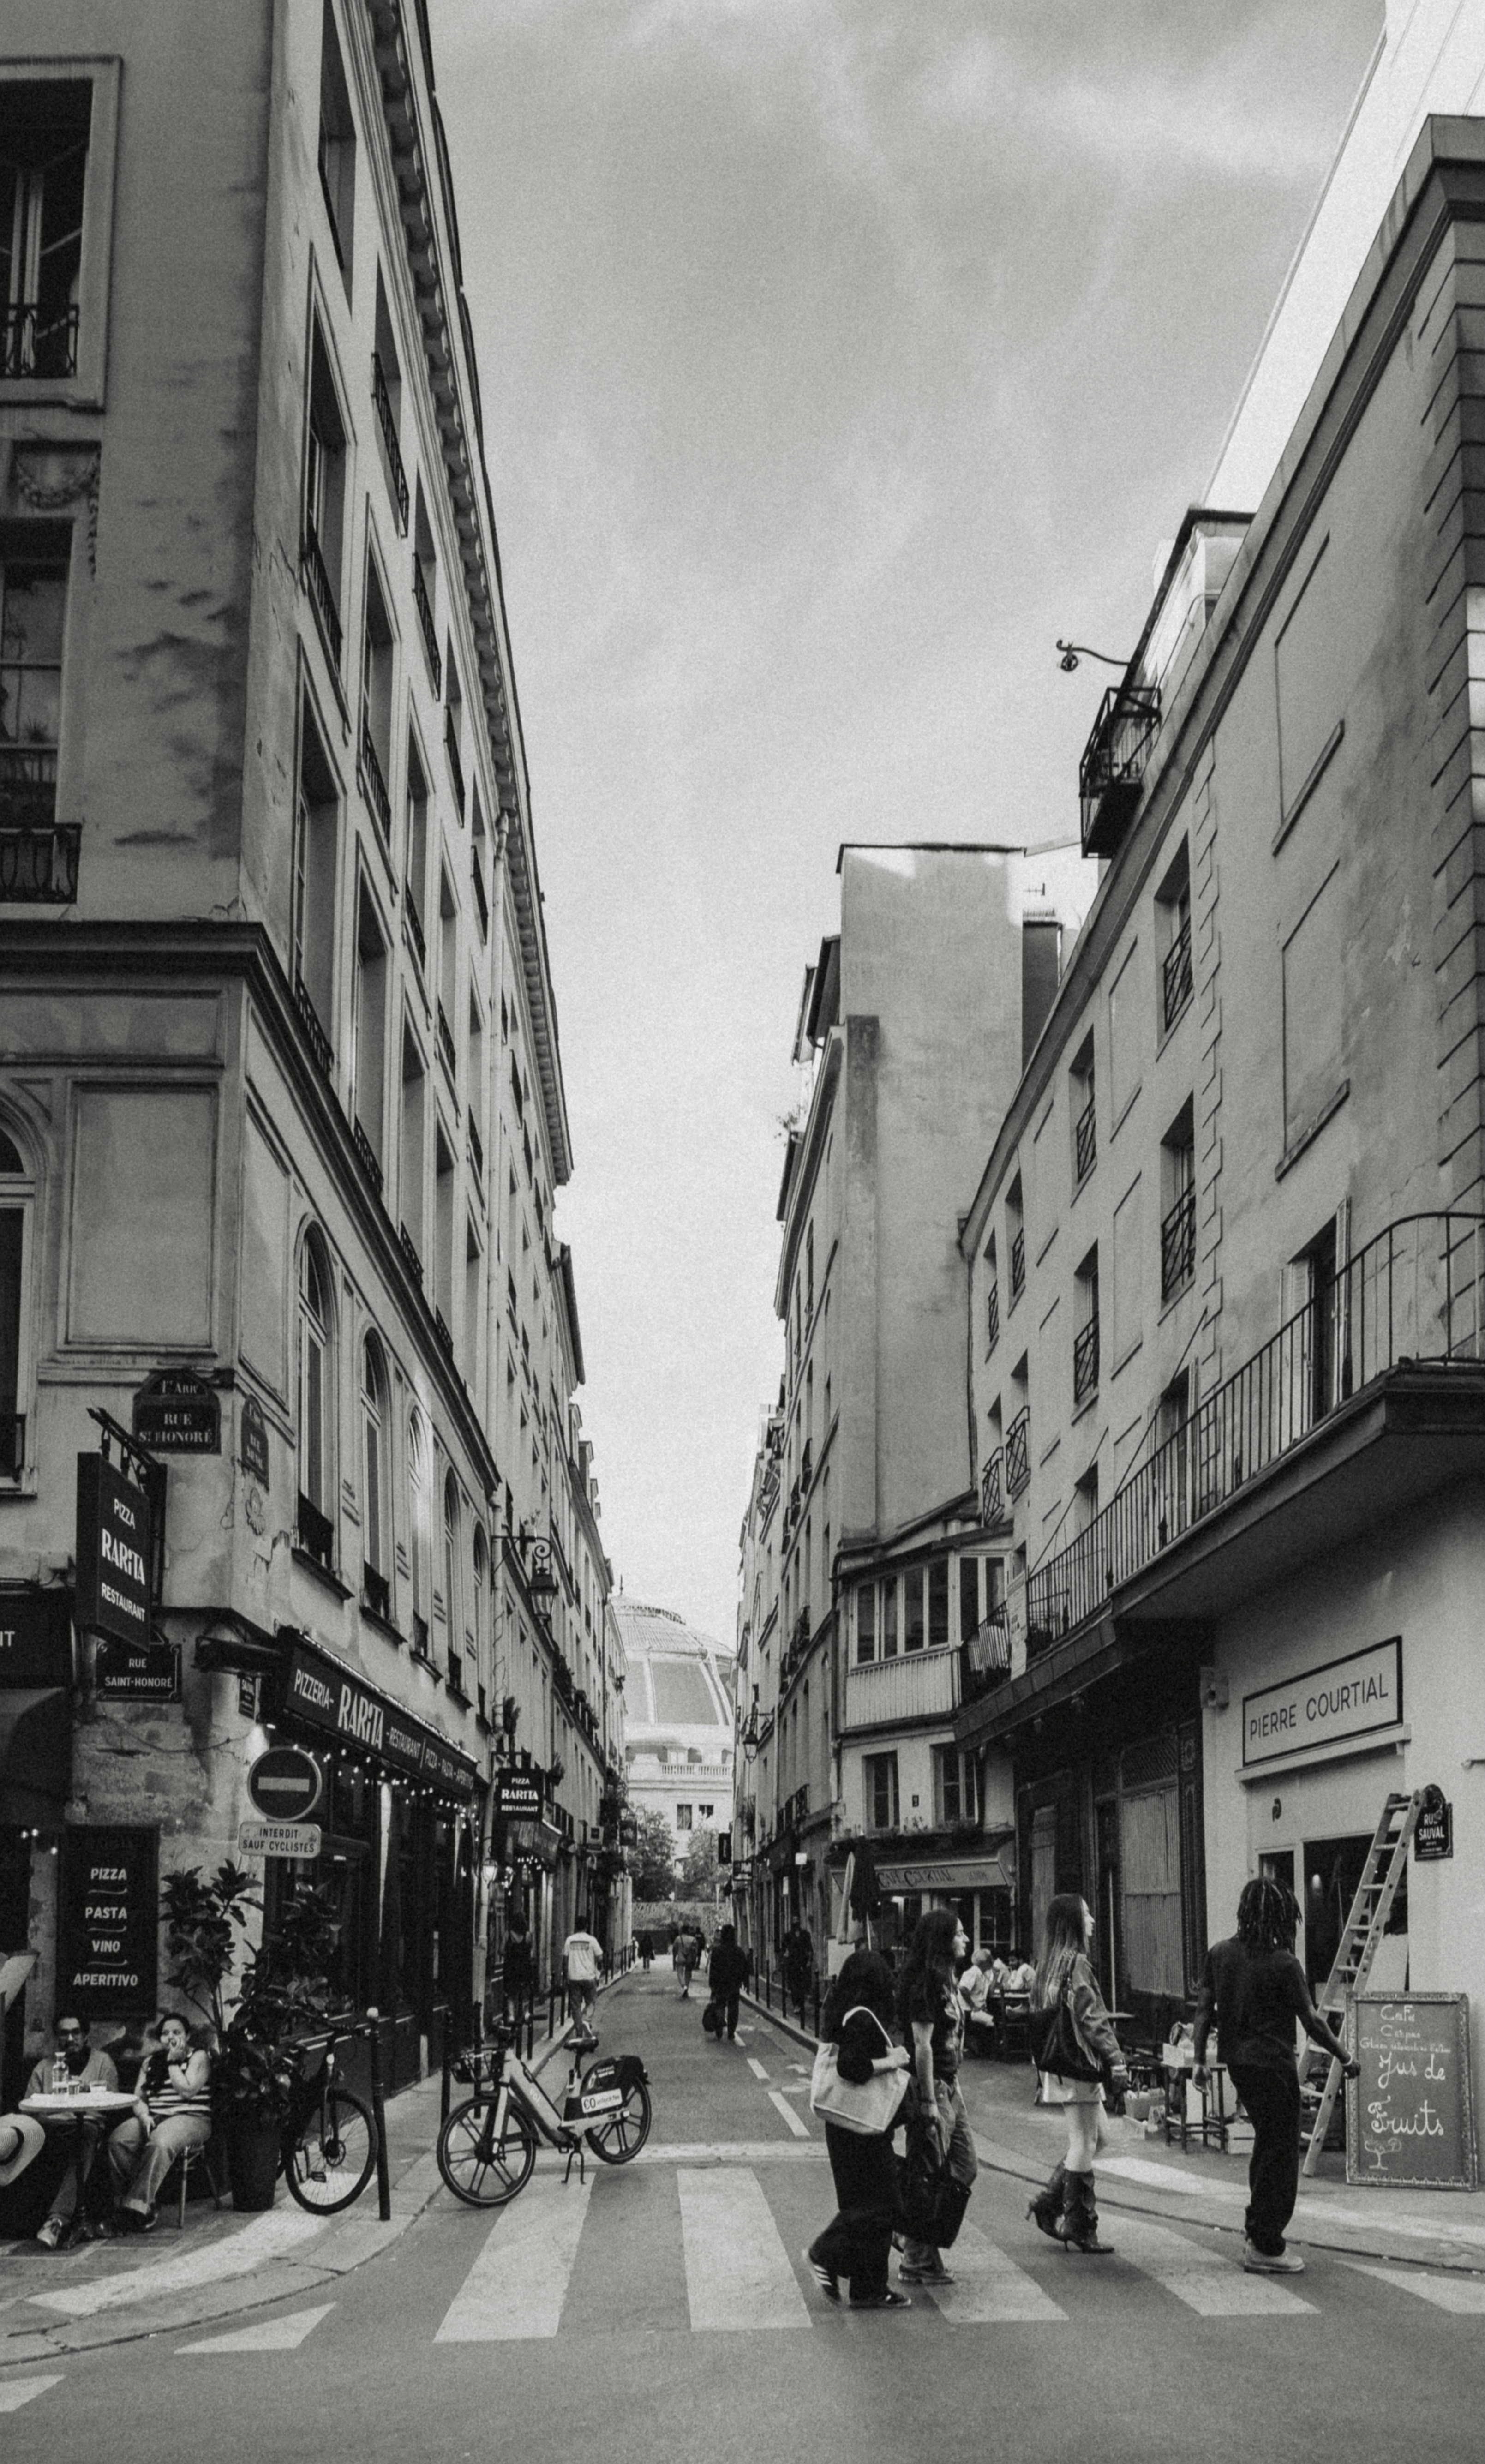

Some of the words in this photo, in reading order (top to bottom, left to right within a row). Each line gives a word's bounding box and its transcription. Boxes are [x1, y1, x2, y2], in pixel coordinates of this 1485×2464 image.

[164, 1414, 192, 1425] RUE
[156, 1428, 212, 1442] HONORÉ
[114, 1498, 135, 1529] PIZZA
[102, 1582, 145, 1622] RESTAURANT
[129, 1658, 147, 1668] RUE
[105, 1676, 172, 1688] SAINT-HONORÉ
[1251, 1704, 1296, 1740] PIERRE
[1306, 1673, 1388, 1721] COURTIAL
[260, 1827, 298, 1839] INTERDIT
[1419, 1826, 1444, 1841] SAUVAL
[243, 1840, 265, 1850] SAUF
[269, 1841, 314, 1853] CYCLISTES
[90, 1868, 127, 1880] PIZZA
[85, 1906, 127, 1919] PASTA
[92, 1940, 120, 1952] VINO
[73, 1973, 138, 1986] APERITIVO
[1424, 2053, 1445, 2080] de
[1368, 2095, 1444, 2136] Fruits
